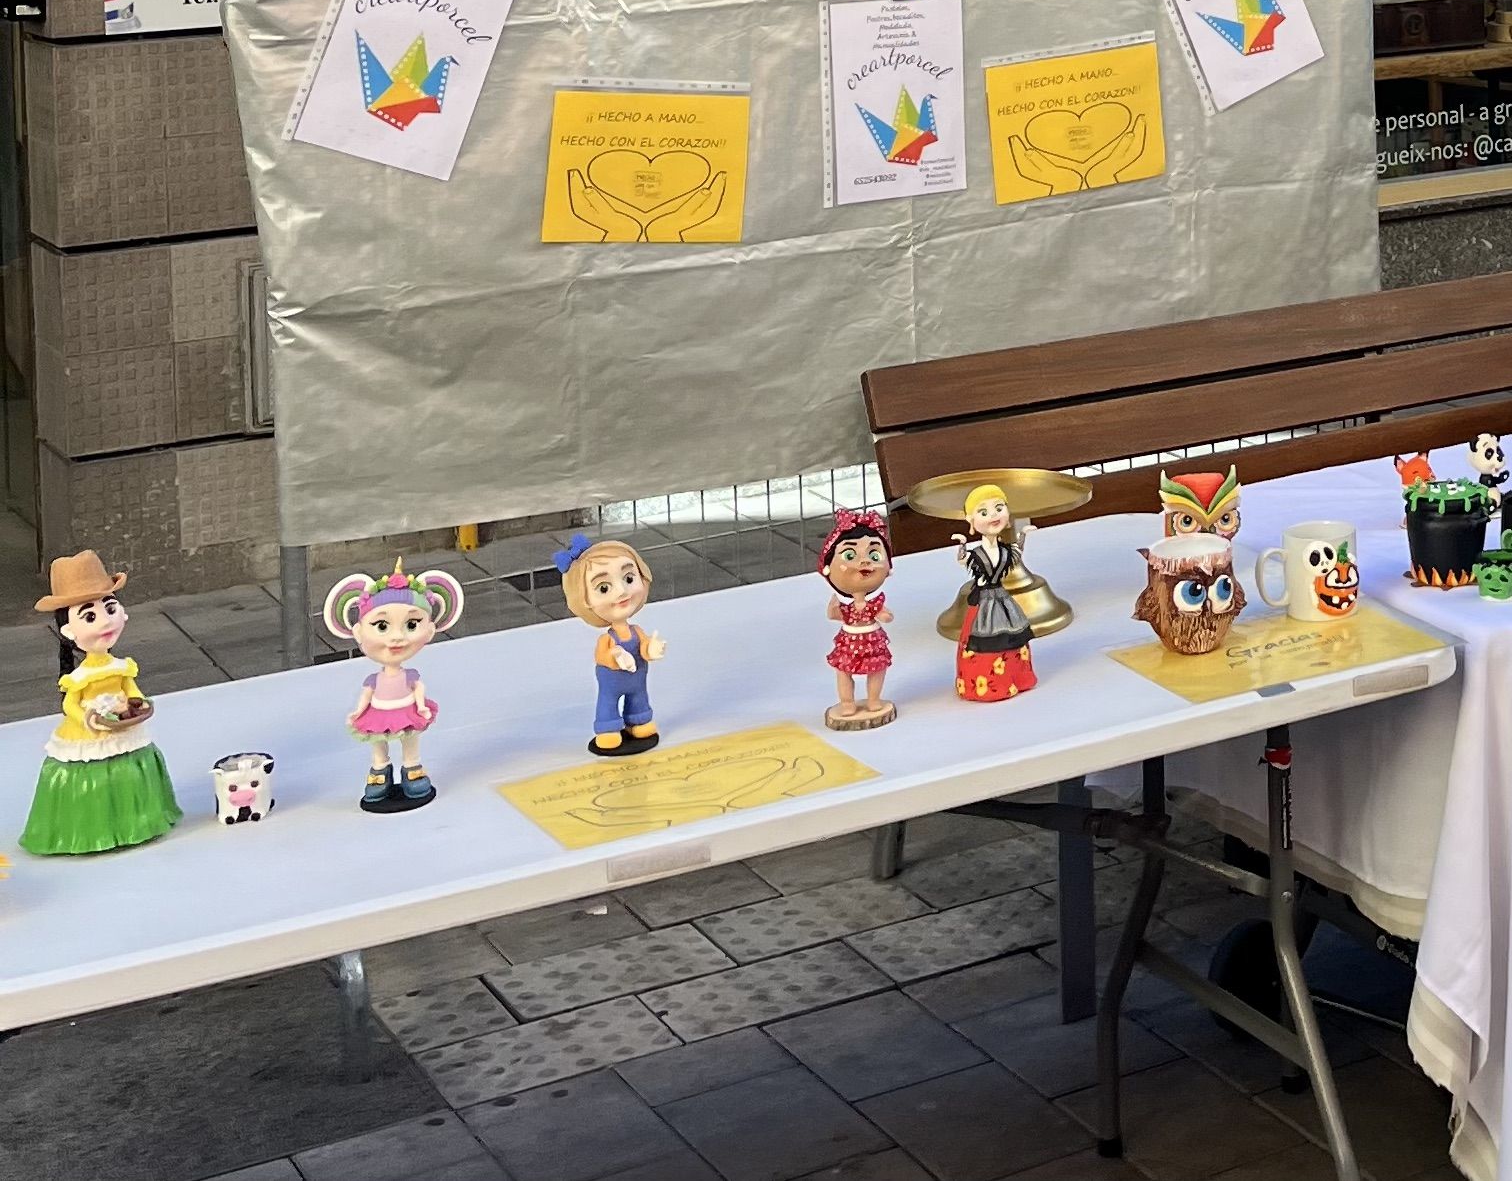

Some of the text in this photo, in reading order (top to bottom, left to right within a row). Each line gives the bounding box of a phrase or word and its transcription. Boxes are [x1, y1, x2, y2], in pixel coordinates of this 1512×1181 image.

[847, 47, 954, 91] creartporcel
[1024, 74, 1064, 90] HECHO
[1067, 73, 1078, 84] A
[597, 110, 642, 123] HECHO
[643, 112, 655, 123] A
[996, 101, 1036, 117] HECHO
[1038, 97, 1064, 110] CON
[1066, 95, 1081, 107] EL
[1385, 103, 1464, 137] personal
[1478, 106, 1490, 121] a
[559, 134, 606, 147] HECHO
[608, 135, 637, 148] CON
[639, 136, 656, 149] EL
[1375, 141, 1469, 175] gueix-nos:
[1225, 632, 1323, 658] Gracias
